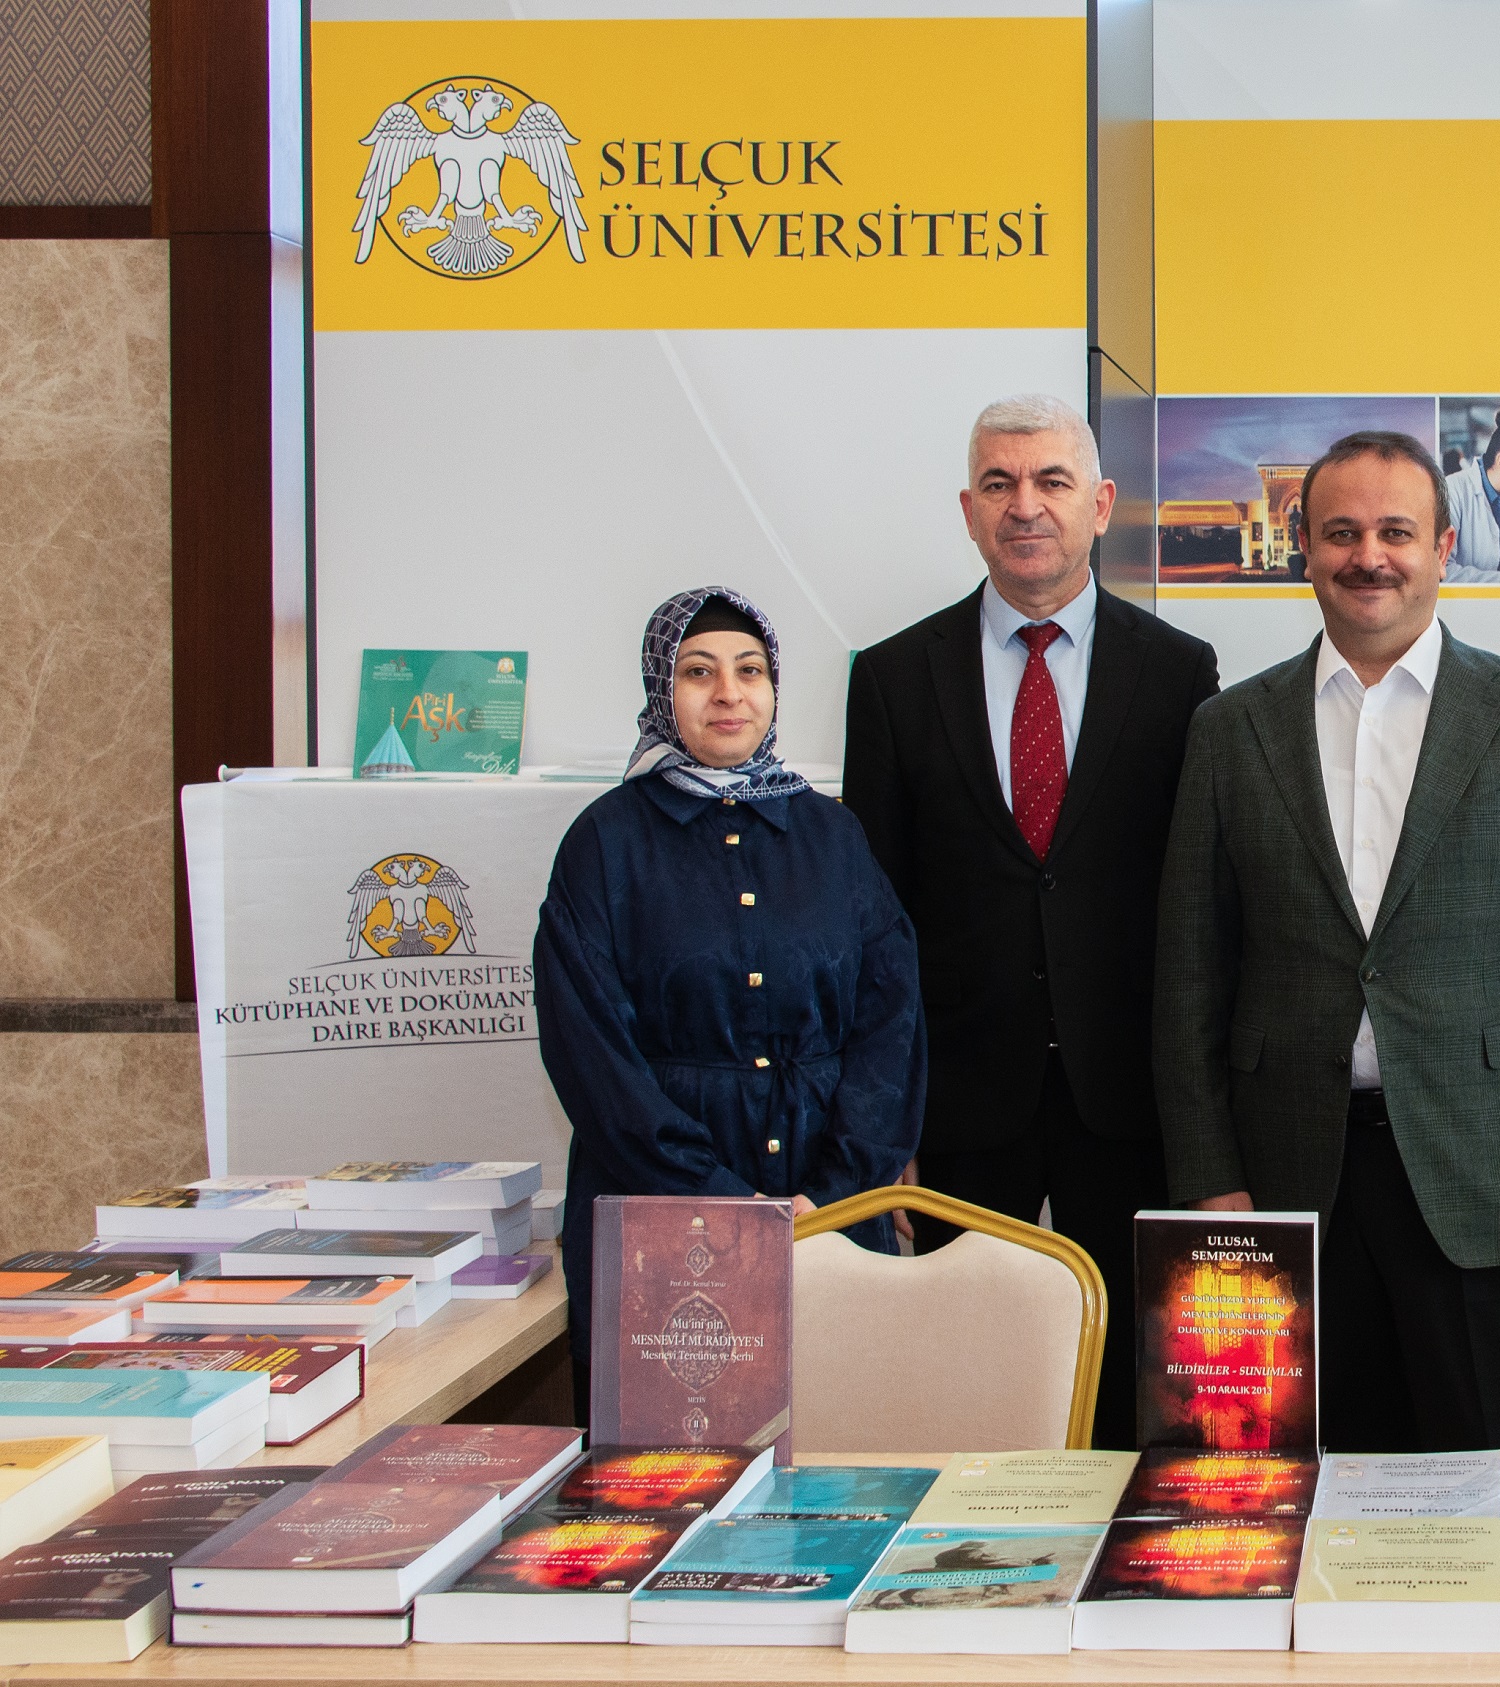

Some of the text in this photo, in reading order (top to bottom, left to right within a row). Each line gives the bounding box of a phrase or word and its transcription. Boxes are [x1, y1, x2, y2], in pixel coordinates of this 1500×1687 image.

[599, 137, 843, 200] SELÇUK
[599, 202, 1049, 262] ÜNİVERSİTESİ
[401, 693, 466, 743] Aşk
[289, 964, 533, 996] SELÇUK ÜNİVERSİTES
[215, 989, 537, 1025] KÜTÜPHANE VE DOKÜMANT
[312, 1013, 526, 1043] DAİRE BAŞKANLIĞI
[1208, 1236, 1258, 1247] ULUSAL
[1192, 1251, 1274, 1263] SEMPOZYUM
[1181, 1293, 1245, 1304] GÜNÜMÜZDE
[1178, 1326, 1215, 1334] DURUM
[1231, 1328, 1290, 1337] KONUMLARI
[732, 1352, 754, 1363] Şerhi
[1166, 1363, 1230, 1376] BİLDİRİLER
[1239, 1366, 1303, 1377] SUNUMLAR
[1197, 1386, 1272, 1395] 9-10 ARALIK 2013
